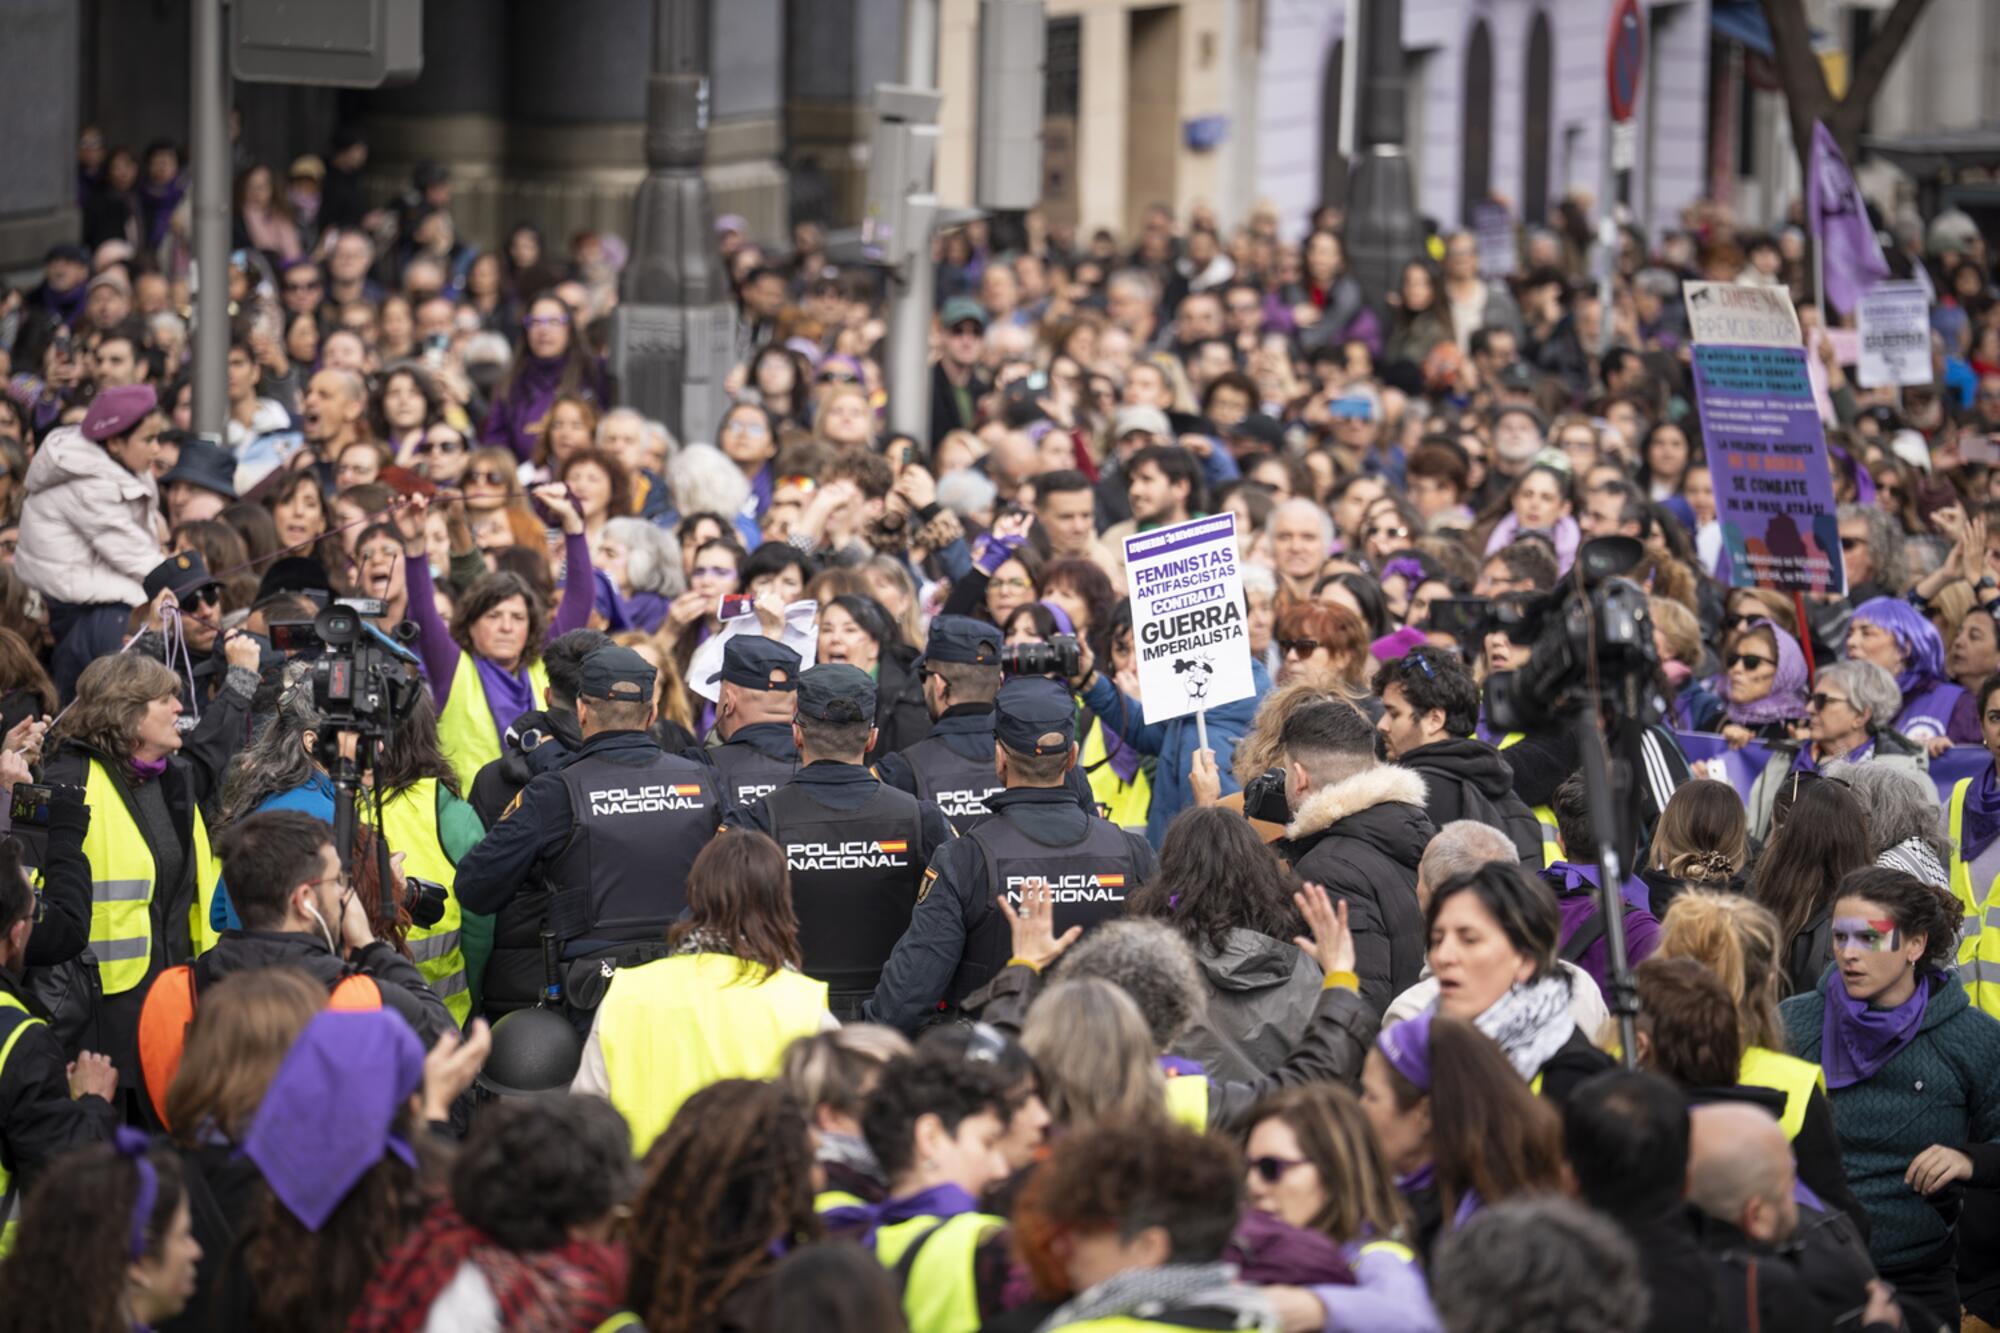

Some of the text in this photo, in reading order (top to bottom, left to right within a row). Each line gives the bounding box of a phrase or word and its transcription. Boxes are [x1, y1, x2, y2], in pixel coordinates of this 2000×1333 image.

[1732, 476, 1808, 496] SE COMBATE
[1135, 547, 1233, 585] FEMINISTAS
[1137, 564, 1236, 600] ANTIFASCISTAS
[1152, 585, 1225, 615] CONTRA LA
[1141, 601, 1241, 645] GUERRA
[1143, 624, 1243, 662] IMPERIALISTA
[589, 784, 680, 803] POLICIA
[592, 797, 704, 816] NACIONAL
[787, 841, 883, 857] POLICIA
[787, 854, 908, 871] NACIONAL
[1006, 875, 1101, 890] POLICIA
